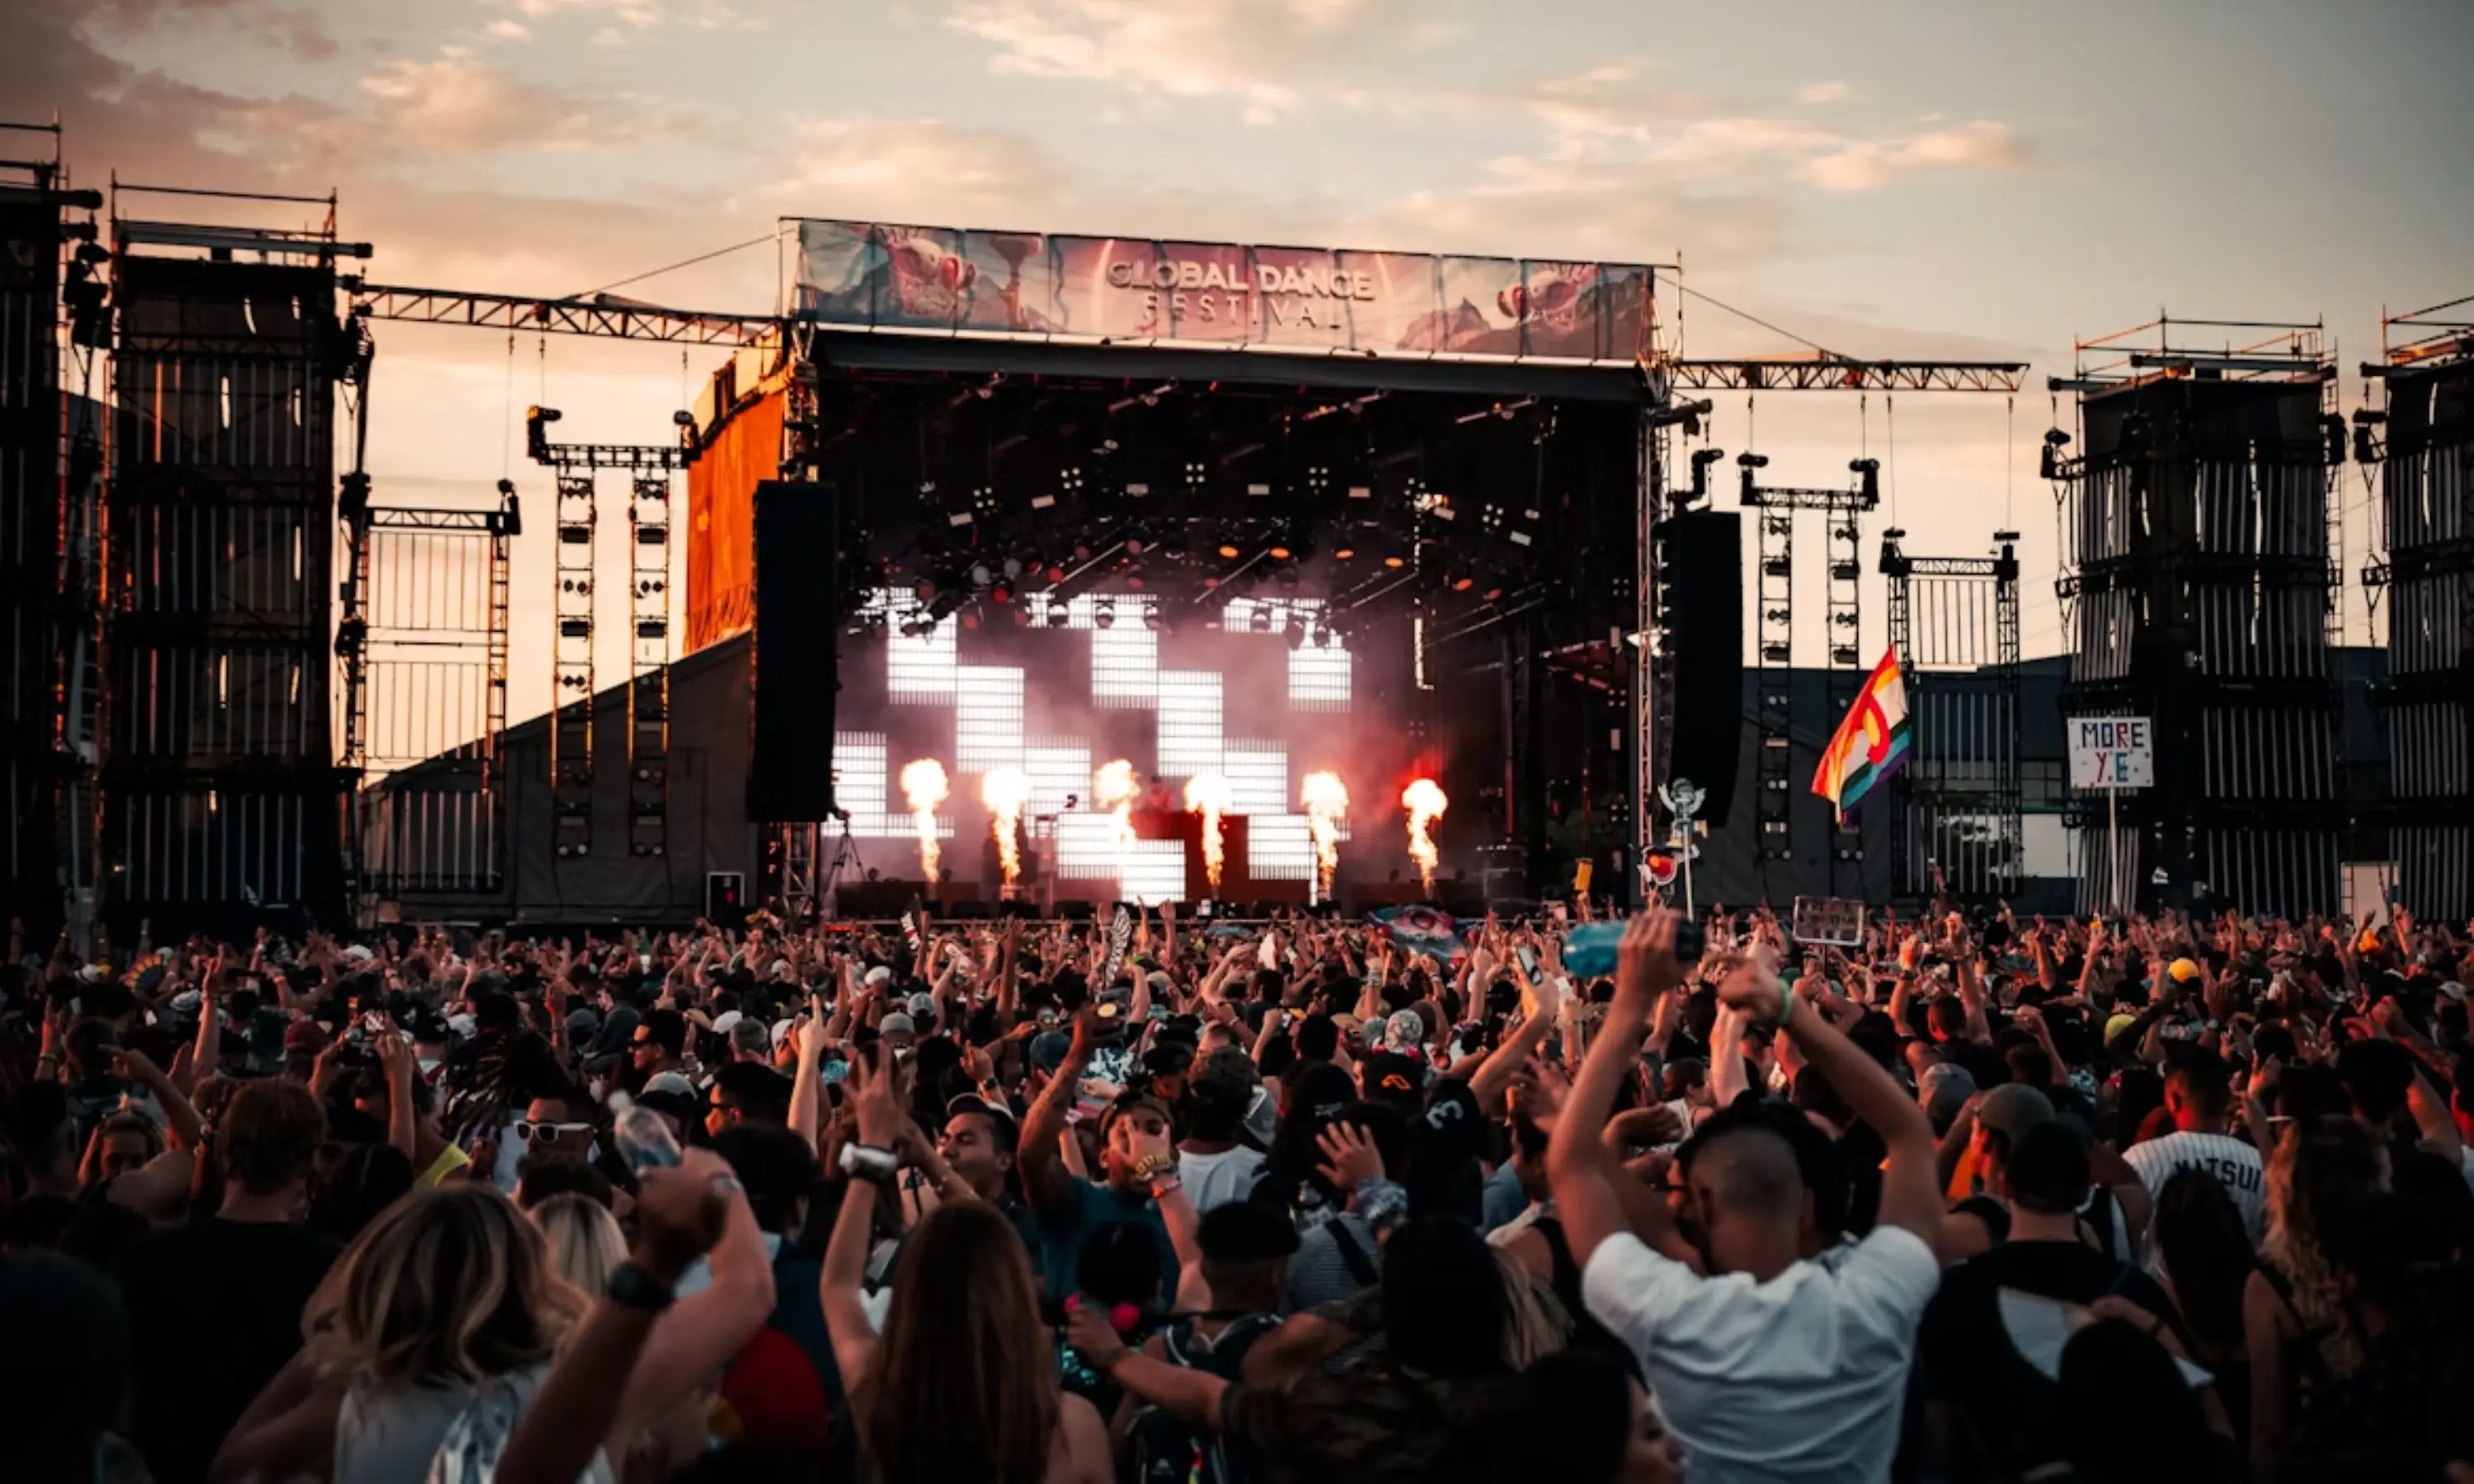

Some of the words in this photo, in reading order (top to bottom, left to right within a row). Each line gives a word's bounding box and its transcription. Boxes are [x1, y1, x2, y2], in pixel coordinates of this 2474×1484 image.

[1107, 260, 1249, 293] GLOBAL
[1257, 264, 1376, 300] DANCE
[1142, 293, 1341, 329] FESTIVAL
[2081, 722, 2144, 749] MORE
[2095, 752, 2128, 782] YE
